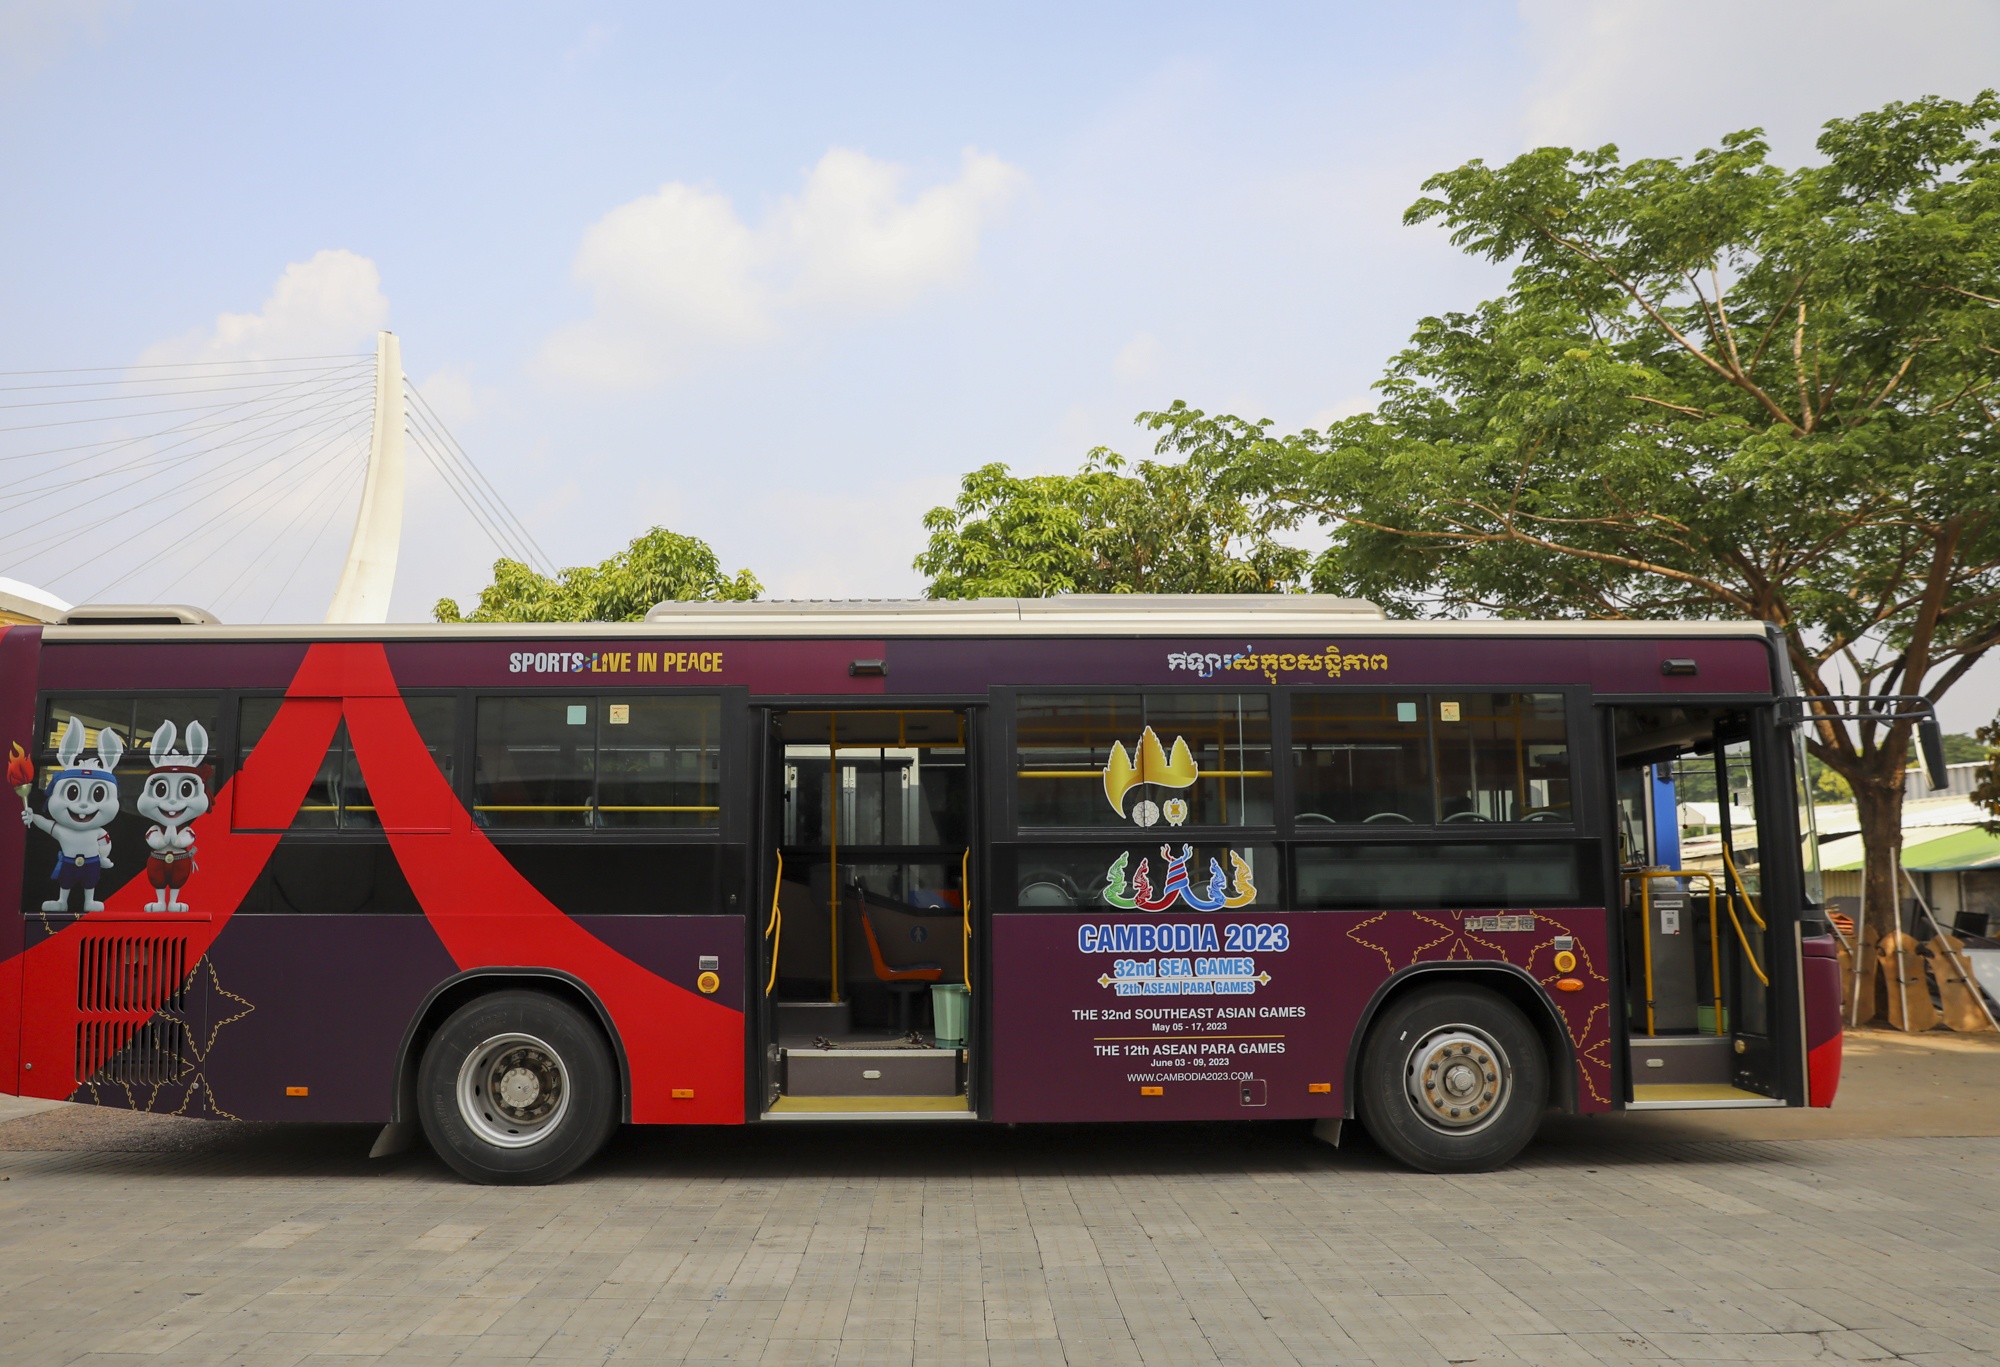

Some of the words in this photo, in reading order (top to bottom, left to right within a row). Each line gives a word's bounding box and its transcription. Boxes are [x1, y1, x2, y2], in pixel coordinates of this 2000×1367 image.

[509, 652, 584, 673] SPORTS
[591, 652, 631, 673] LIVE
[637, 652, 657, 673] IN
[663, 652, 723, 673] PEACE
[1079, 924, 1220, 953] CAMBODIA
[1224, 923, 1289, 952] 2023
[1114, 959, 1157, 978] 32nd
[1159, 958, 1193, 977] SEA
[1195, 957, 1255, 976] GAMES
[1115, 983, 1142, 996] 12th
[1143, 982, 1180, 995] ASEAN
[1182, 982, 1212, 994] PARA
[1214, 981, 1255, 994] GAMES
[1072, 1010, 1098, 1020] THE
[1101, 1009, 1131, 1020] 32nd
[1135, 1008, 1214, 1020] SOUTHEAST
[1216, 1007, 1256, 1018] ASIAN
[1259, 1007, 1306, 1018] GAMES
[1152, 1023, 1171, 1033] May
[1172, 1023, 1183, 1031] 05
[1191, 1023, 1204, 1032] 17,
[1206, 1022, 1227, 1031] 2023
[1094, 1045, 1120, 1056] THE
[1124, 1045, 1149, 1055] 12th
[1152, 1044, 1197, 1055] ASEAN
[1201, 1044, 1236, 1054] PARA
[1238, 1043, 1286, 1054] GAMES
[1150, 1059, 1173, 1067] June
[1175, 1059, 1186, 1067] 03
[1193, 1058, 1206, 1067] 09,
[1208, 1058, 1229, 1066] 2023
[1127, 1072, 1254, 1082] WWW.CAMBODIA2023.COM
